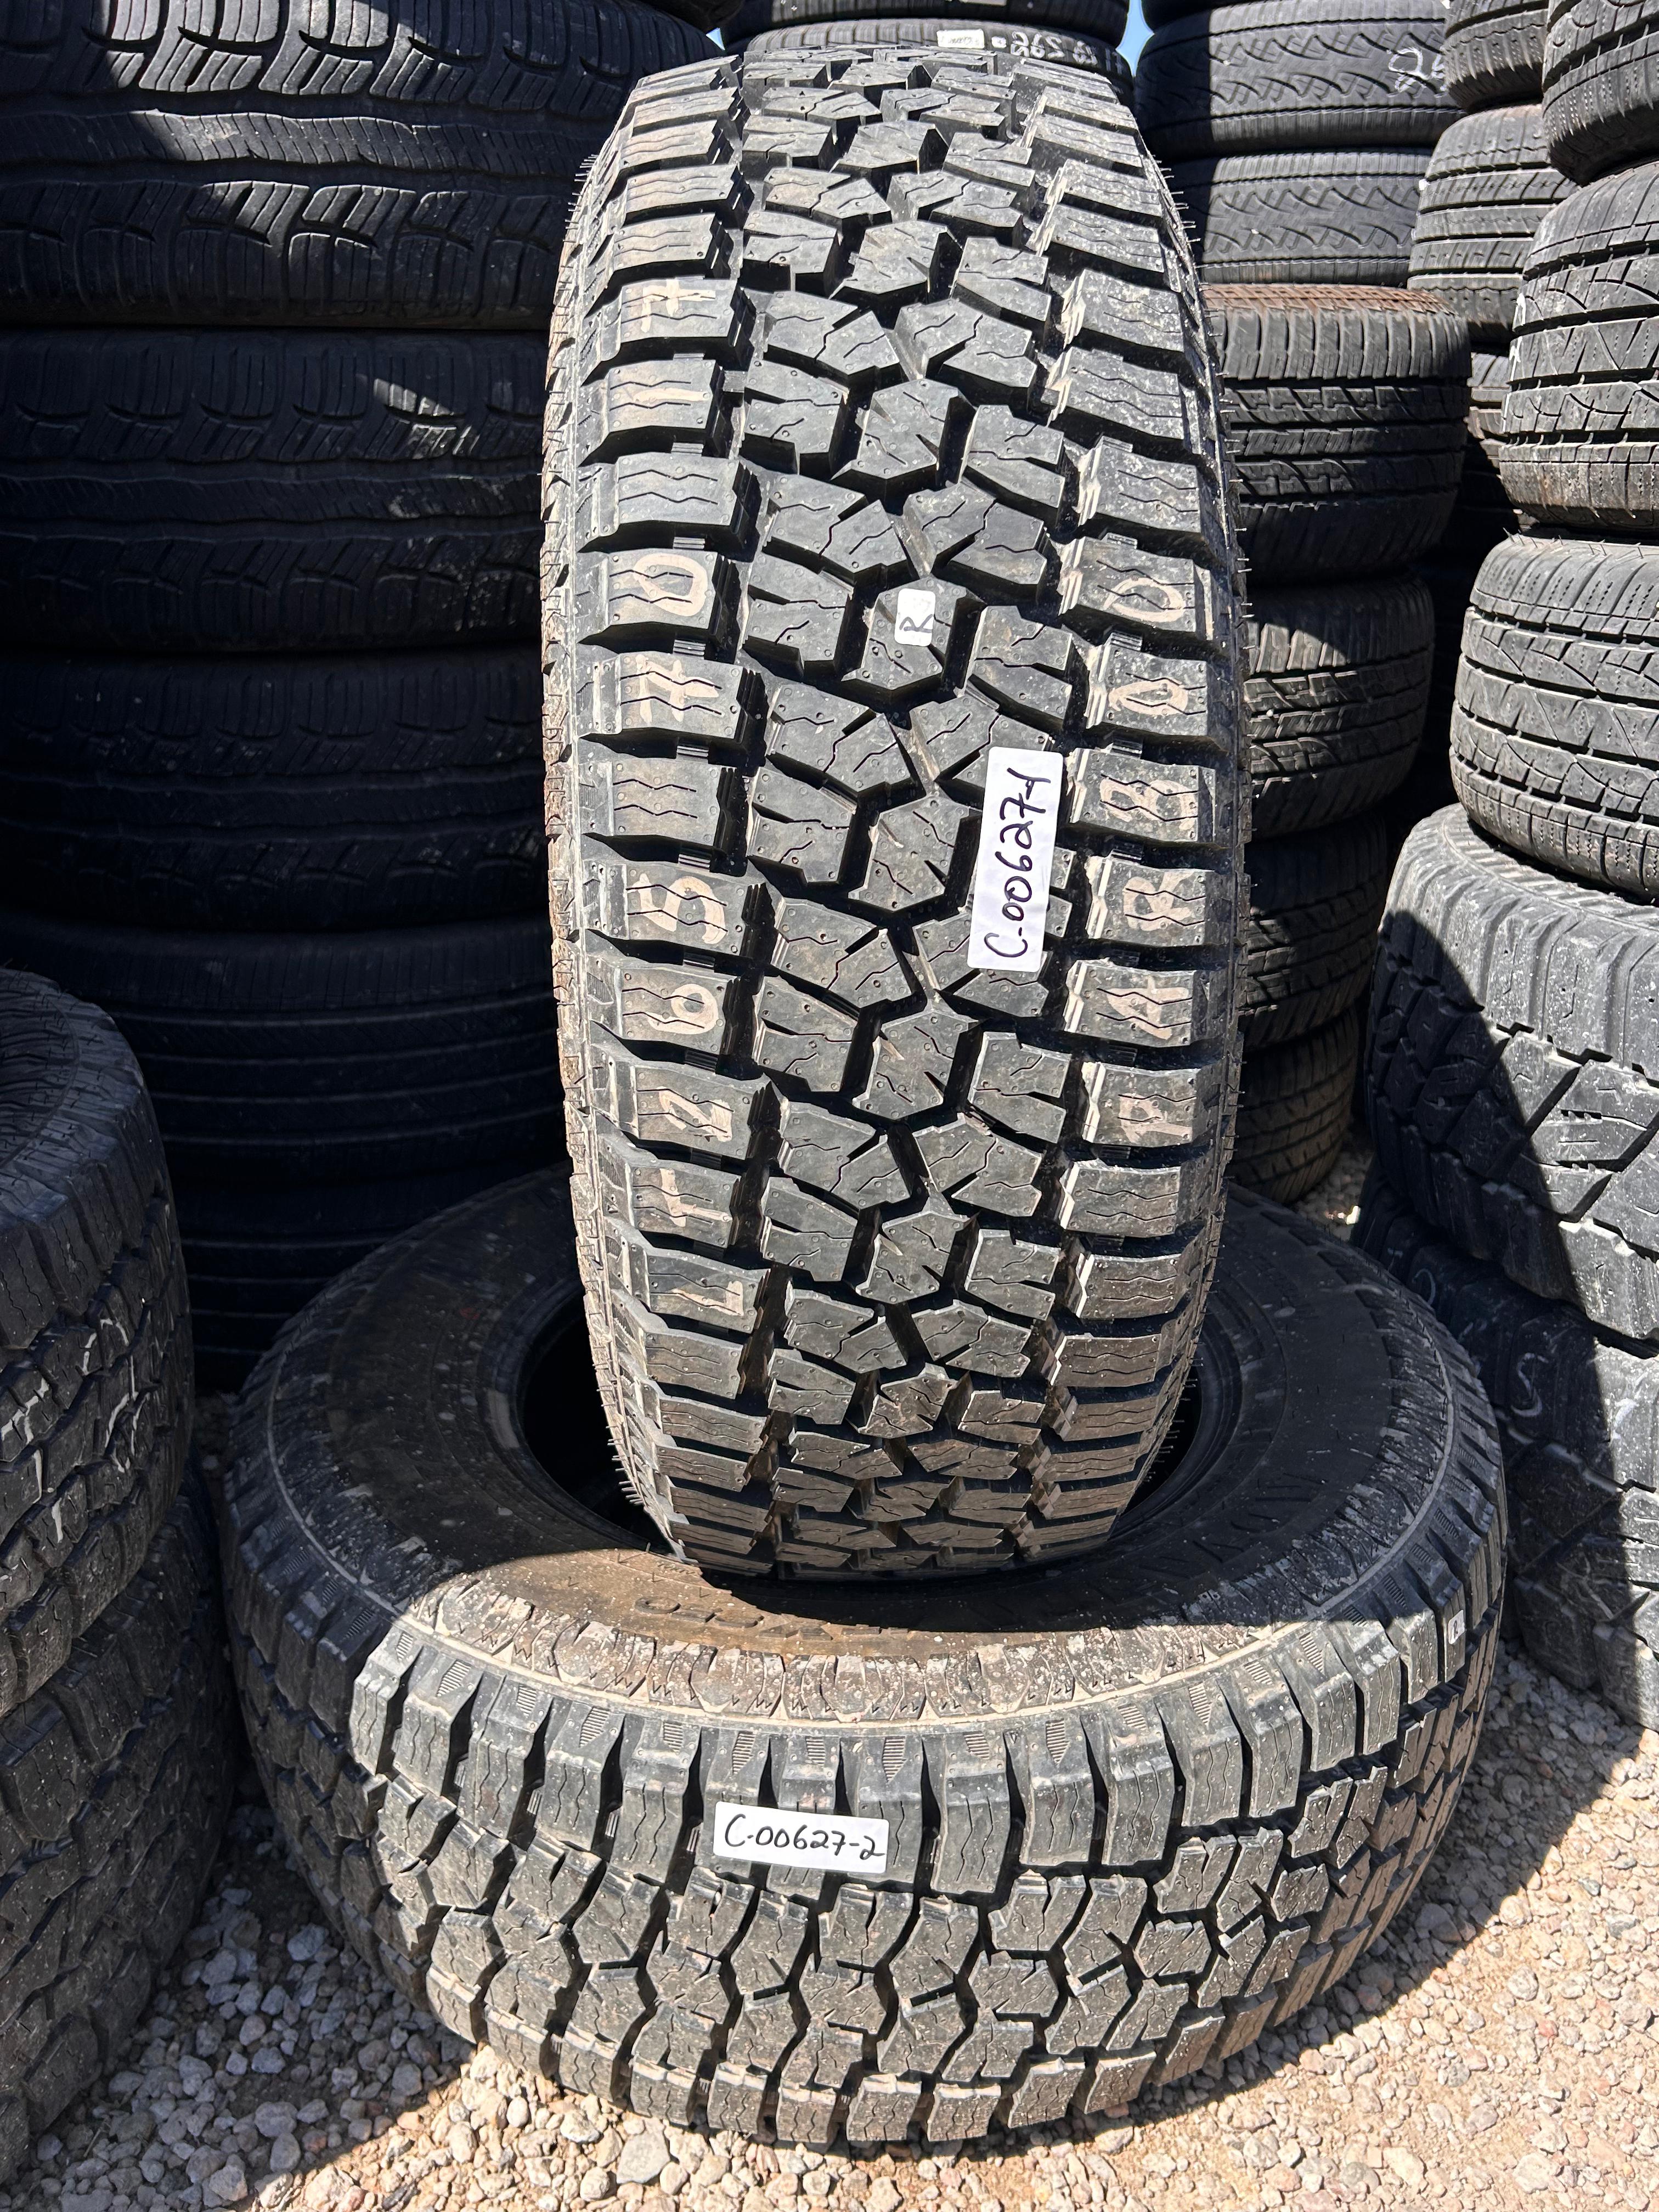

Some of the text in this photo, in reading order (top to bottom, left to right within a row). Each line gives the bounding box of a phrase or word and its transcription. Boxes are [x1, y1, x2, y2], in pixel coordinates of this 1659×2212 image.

[633, 552, 720, 724] 70
[899, 613, 934, 634] R
[724, 1813, 886, 1860] C-00627-2
